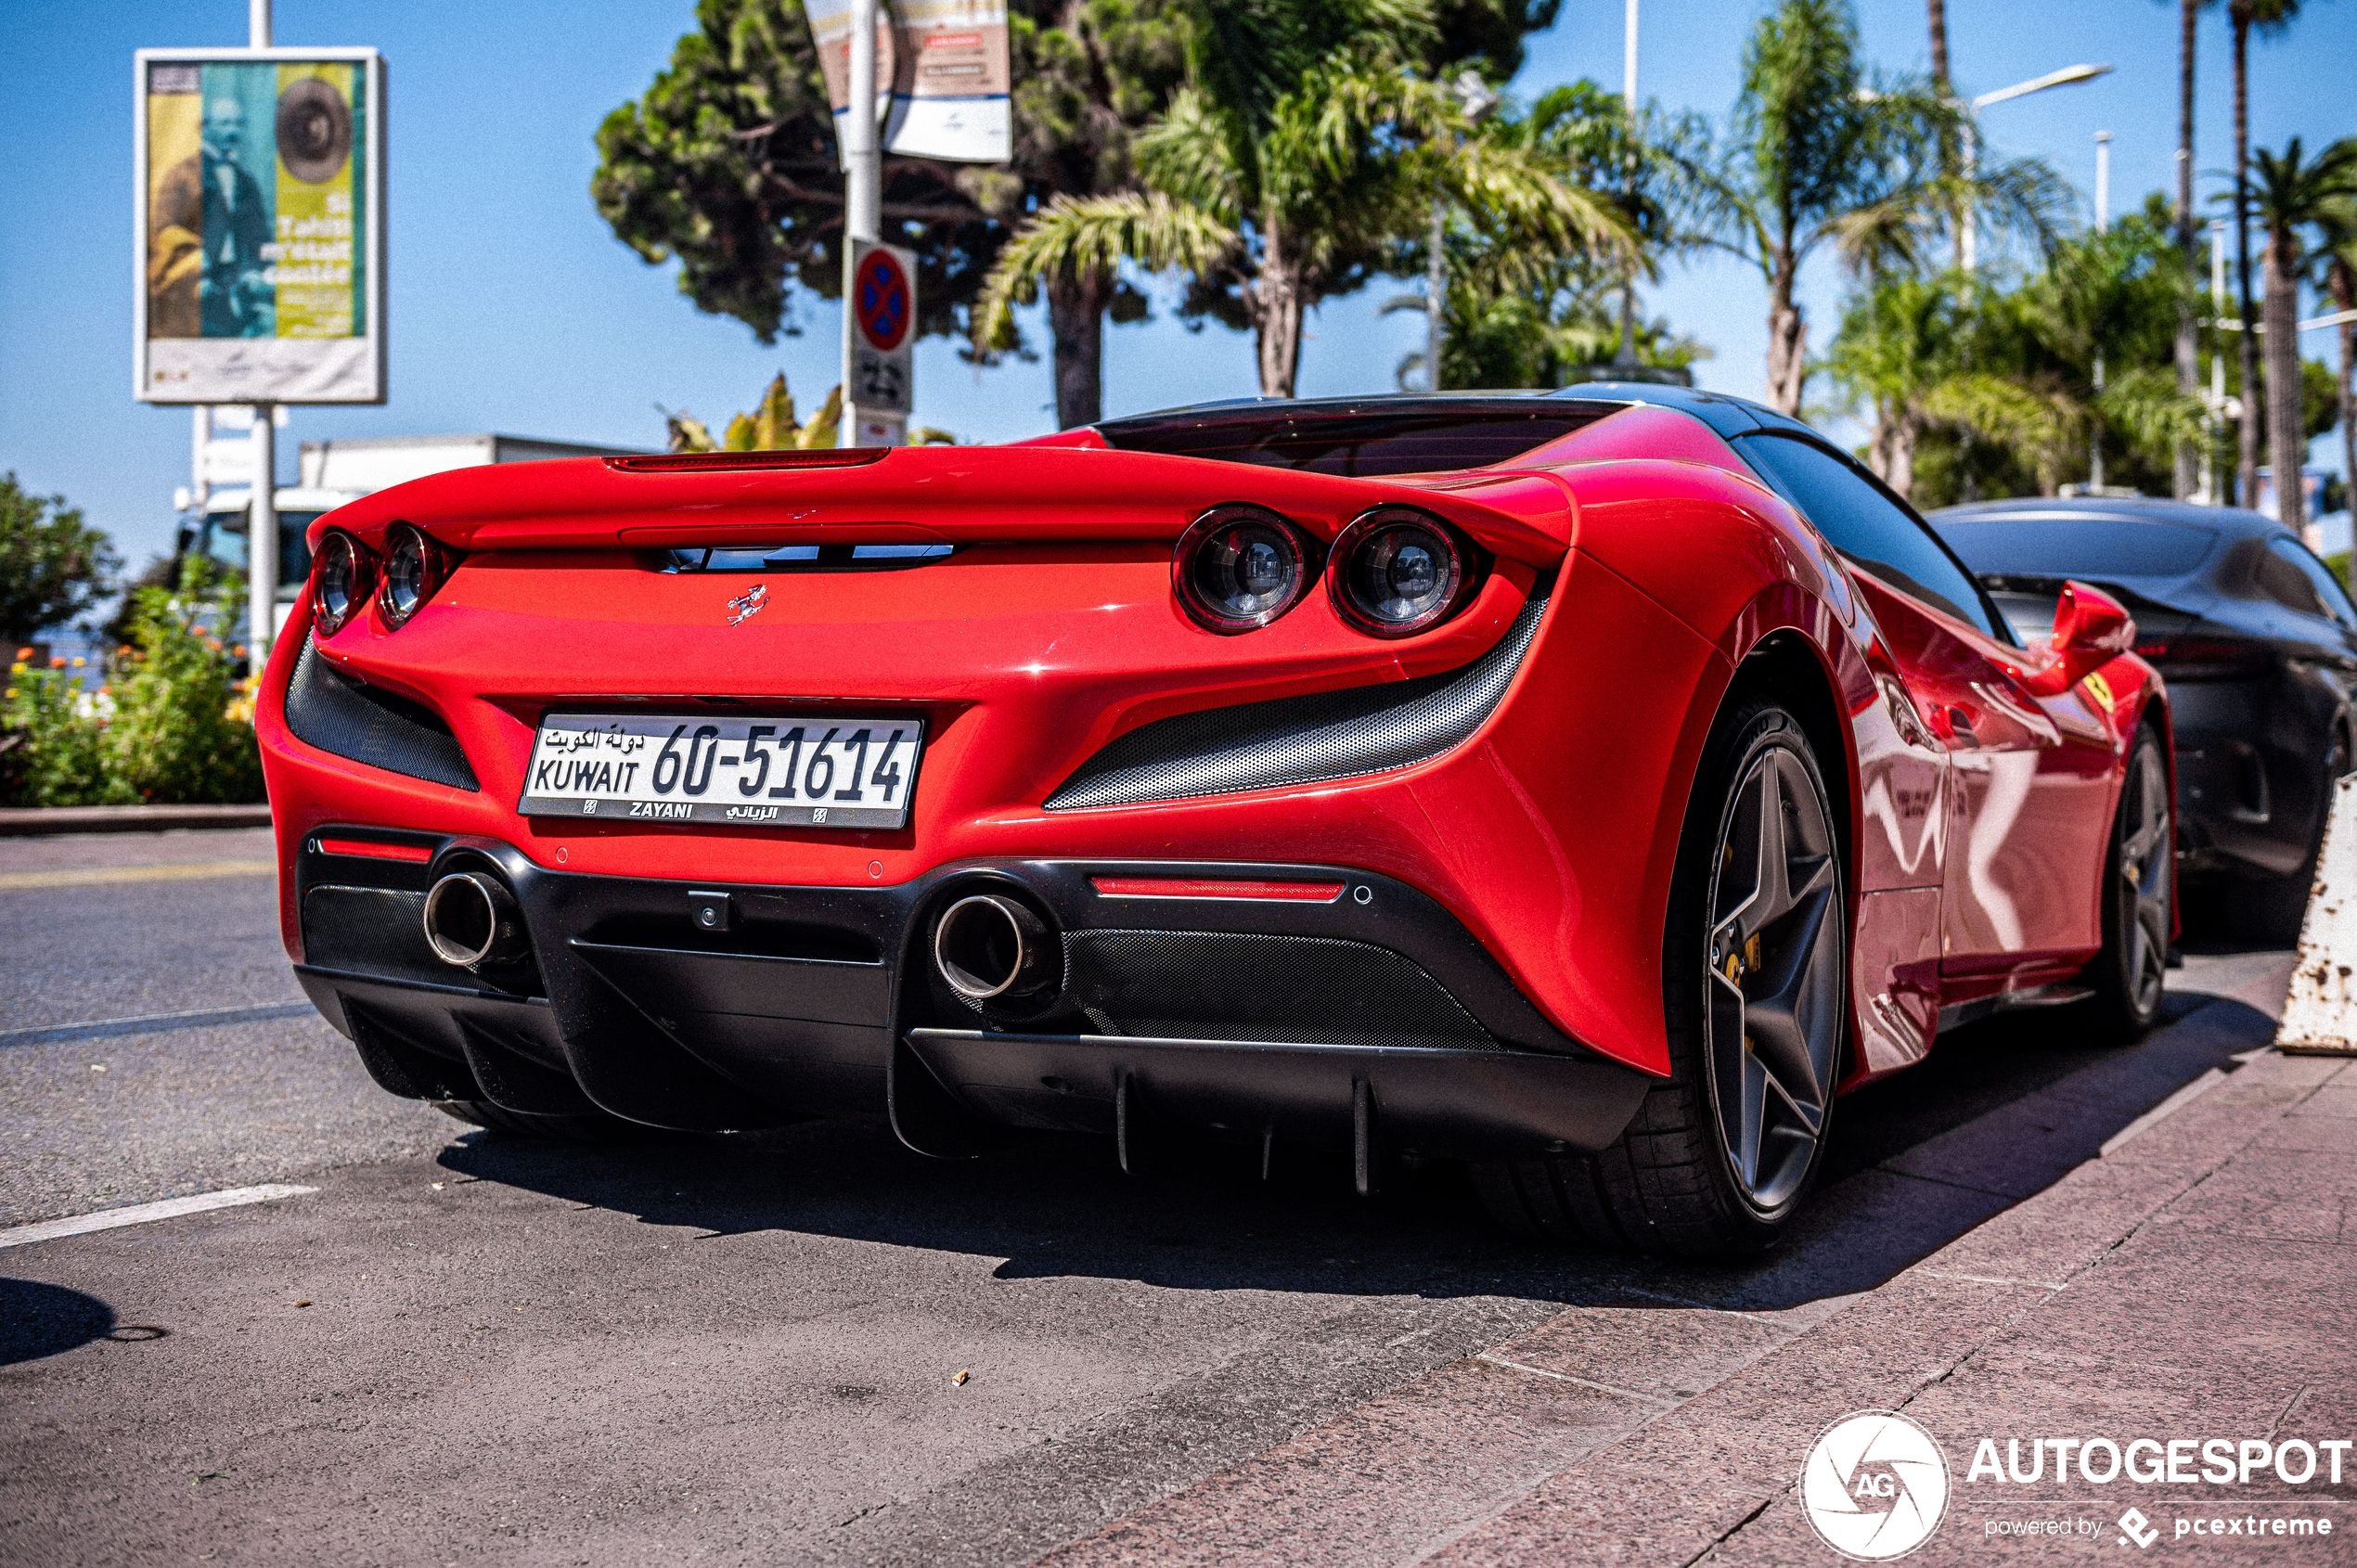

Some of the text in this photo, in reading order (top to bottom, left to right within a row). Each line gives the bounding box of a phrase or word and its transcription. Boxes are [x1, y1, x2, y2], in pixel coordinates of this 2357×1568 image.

[546, 724, 645, 754] دولة الكويت
[535, 759, 640, 794] KUWAIT
[651, 724, 905, 802] 60-51614
[629, 802, 694, 819] ZAYANI
[727, 805, 778, 821] الزياني
